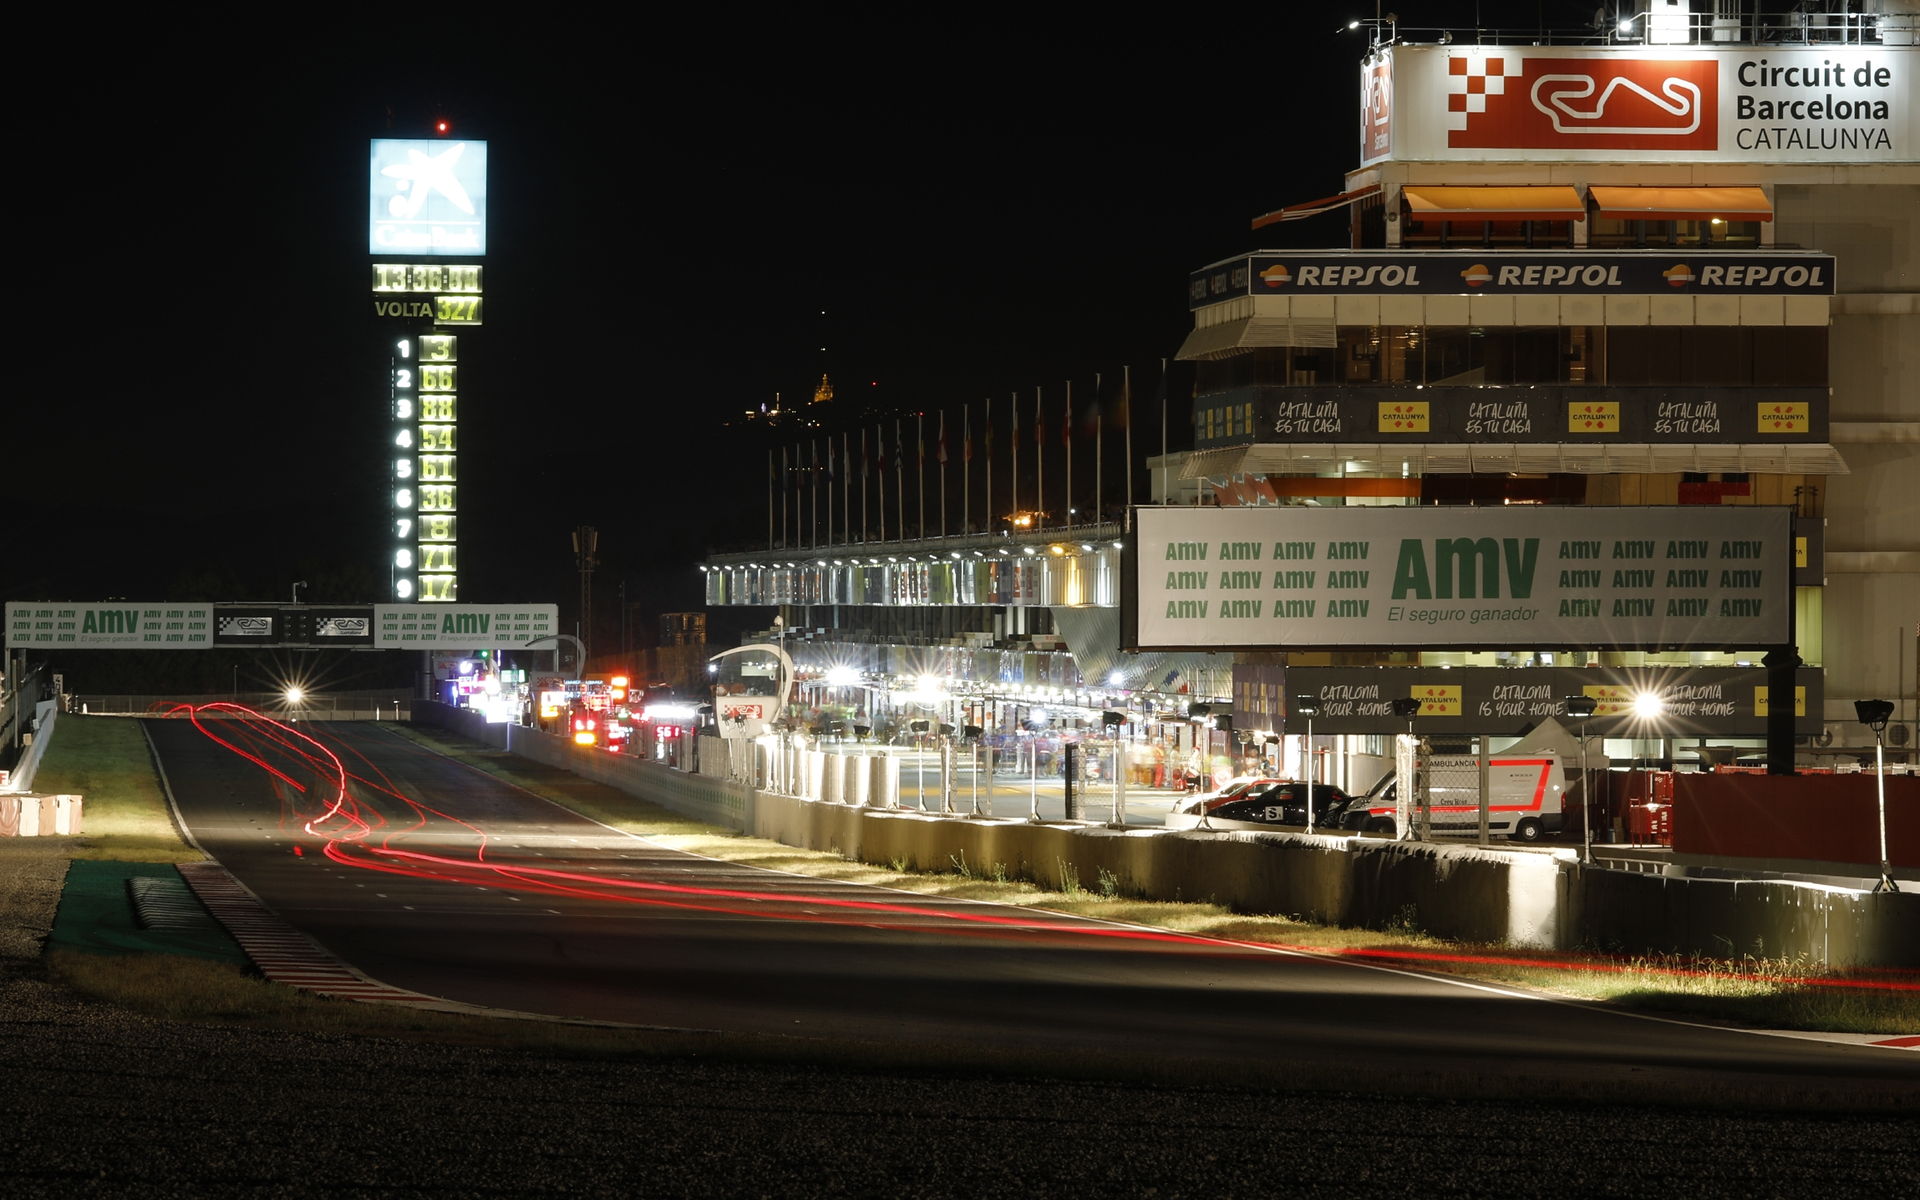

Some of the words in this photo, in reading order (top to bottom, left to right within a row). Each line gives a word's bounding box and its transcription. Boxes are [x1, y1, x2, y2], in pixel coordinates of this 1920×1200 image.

[1738, 60, 1845, 87] Circuit
[1854, 61, 1890, 87] de
[1738, 94, 1888, 120] Barcelona
[1737, 128, 1891, 149] CATALUNYA
[1297, 266, 1419, 286] REPSOL
[1498, 265, 1621, 285] REPSOL
[1701, 266, 1823, 286] REPSOL
[375, 302, 433, 317] VOLTA
[438, 297, 479, 321] 327
[397, 340, 410, 358] 1
[431, 339, 449, 360] 3
[397, 370, 412, 388] 2
[422, 366, 452, 390] 66
[397, 399, 412, 418] 3
[422, 396, 452, 420] 88
[1274, 419, 1293, 434] ES
[1294, 419, 1309, 434] TU
[1310, 418, 1342, 434] CASA
[1464, 419, 1484, 434] ES
[1484, 419, 1500, 434] TU
[1501, 418, 1532, 434] CASA
[1654, 419, 1672, 434] ES
[1672, 419, 1688, 434] TU
[1690, 418, 1721, 434] CASA
[397, 429, 412, 449] 4
[422, 426, 452, 450] 54
[397, 459, 412, 478] 5
[422, 456, 452, 480] 61
[397, 489, 412, 508] 6
[422, 486, 452, 510] 36
[397, 519, 412, 538] 7
[431, 516, 449, 539] 8
[397, 549, 412, 568] 8
[422, 546, 452, 570] 71
[397, 579, 412, 598] 9
[422, 576, 452, 600] 17
[1388, 607, 1404, 622] El
[1408, 610, 1466, 625] seguro
[1470, 607, 1540, 625] ganador
[1320, 685, 1379, 701] CATALONIA
[1492, 685, 1552, 701] CATALONIA
[1664, 684, 1722, 700] CATALONIA
[1323, 700, 1353, 718] YOUR
[1357, 701, 1394, 716] HOME
[1478, 702, 1492, 716] IS
[1495, 700, 1526, 718] YOUR
[1529, 701, 1565, 717] HOME
[1700, 701, 1736, 717] HOME
